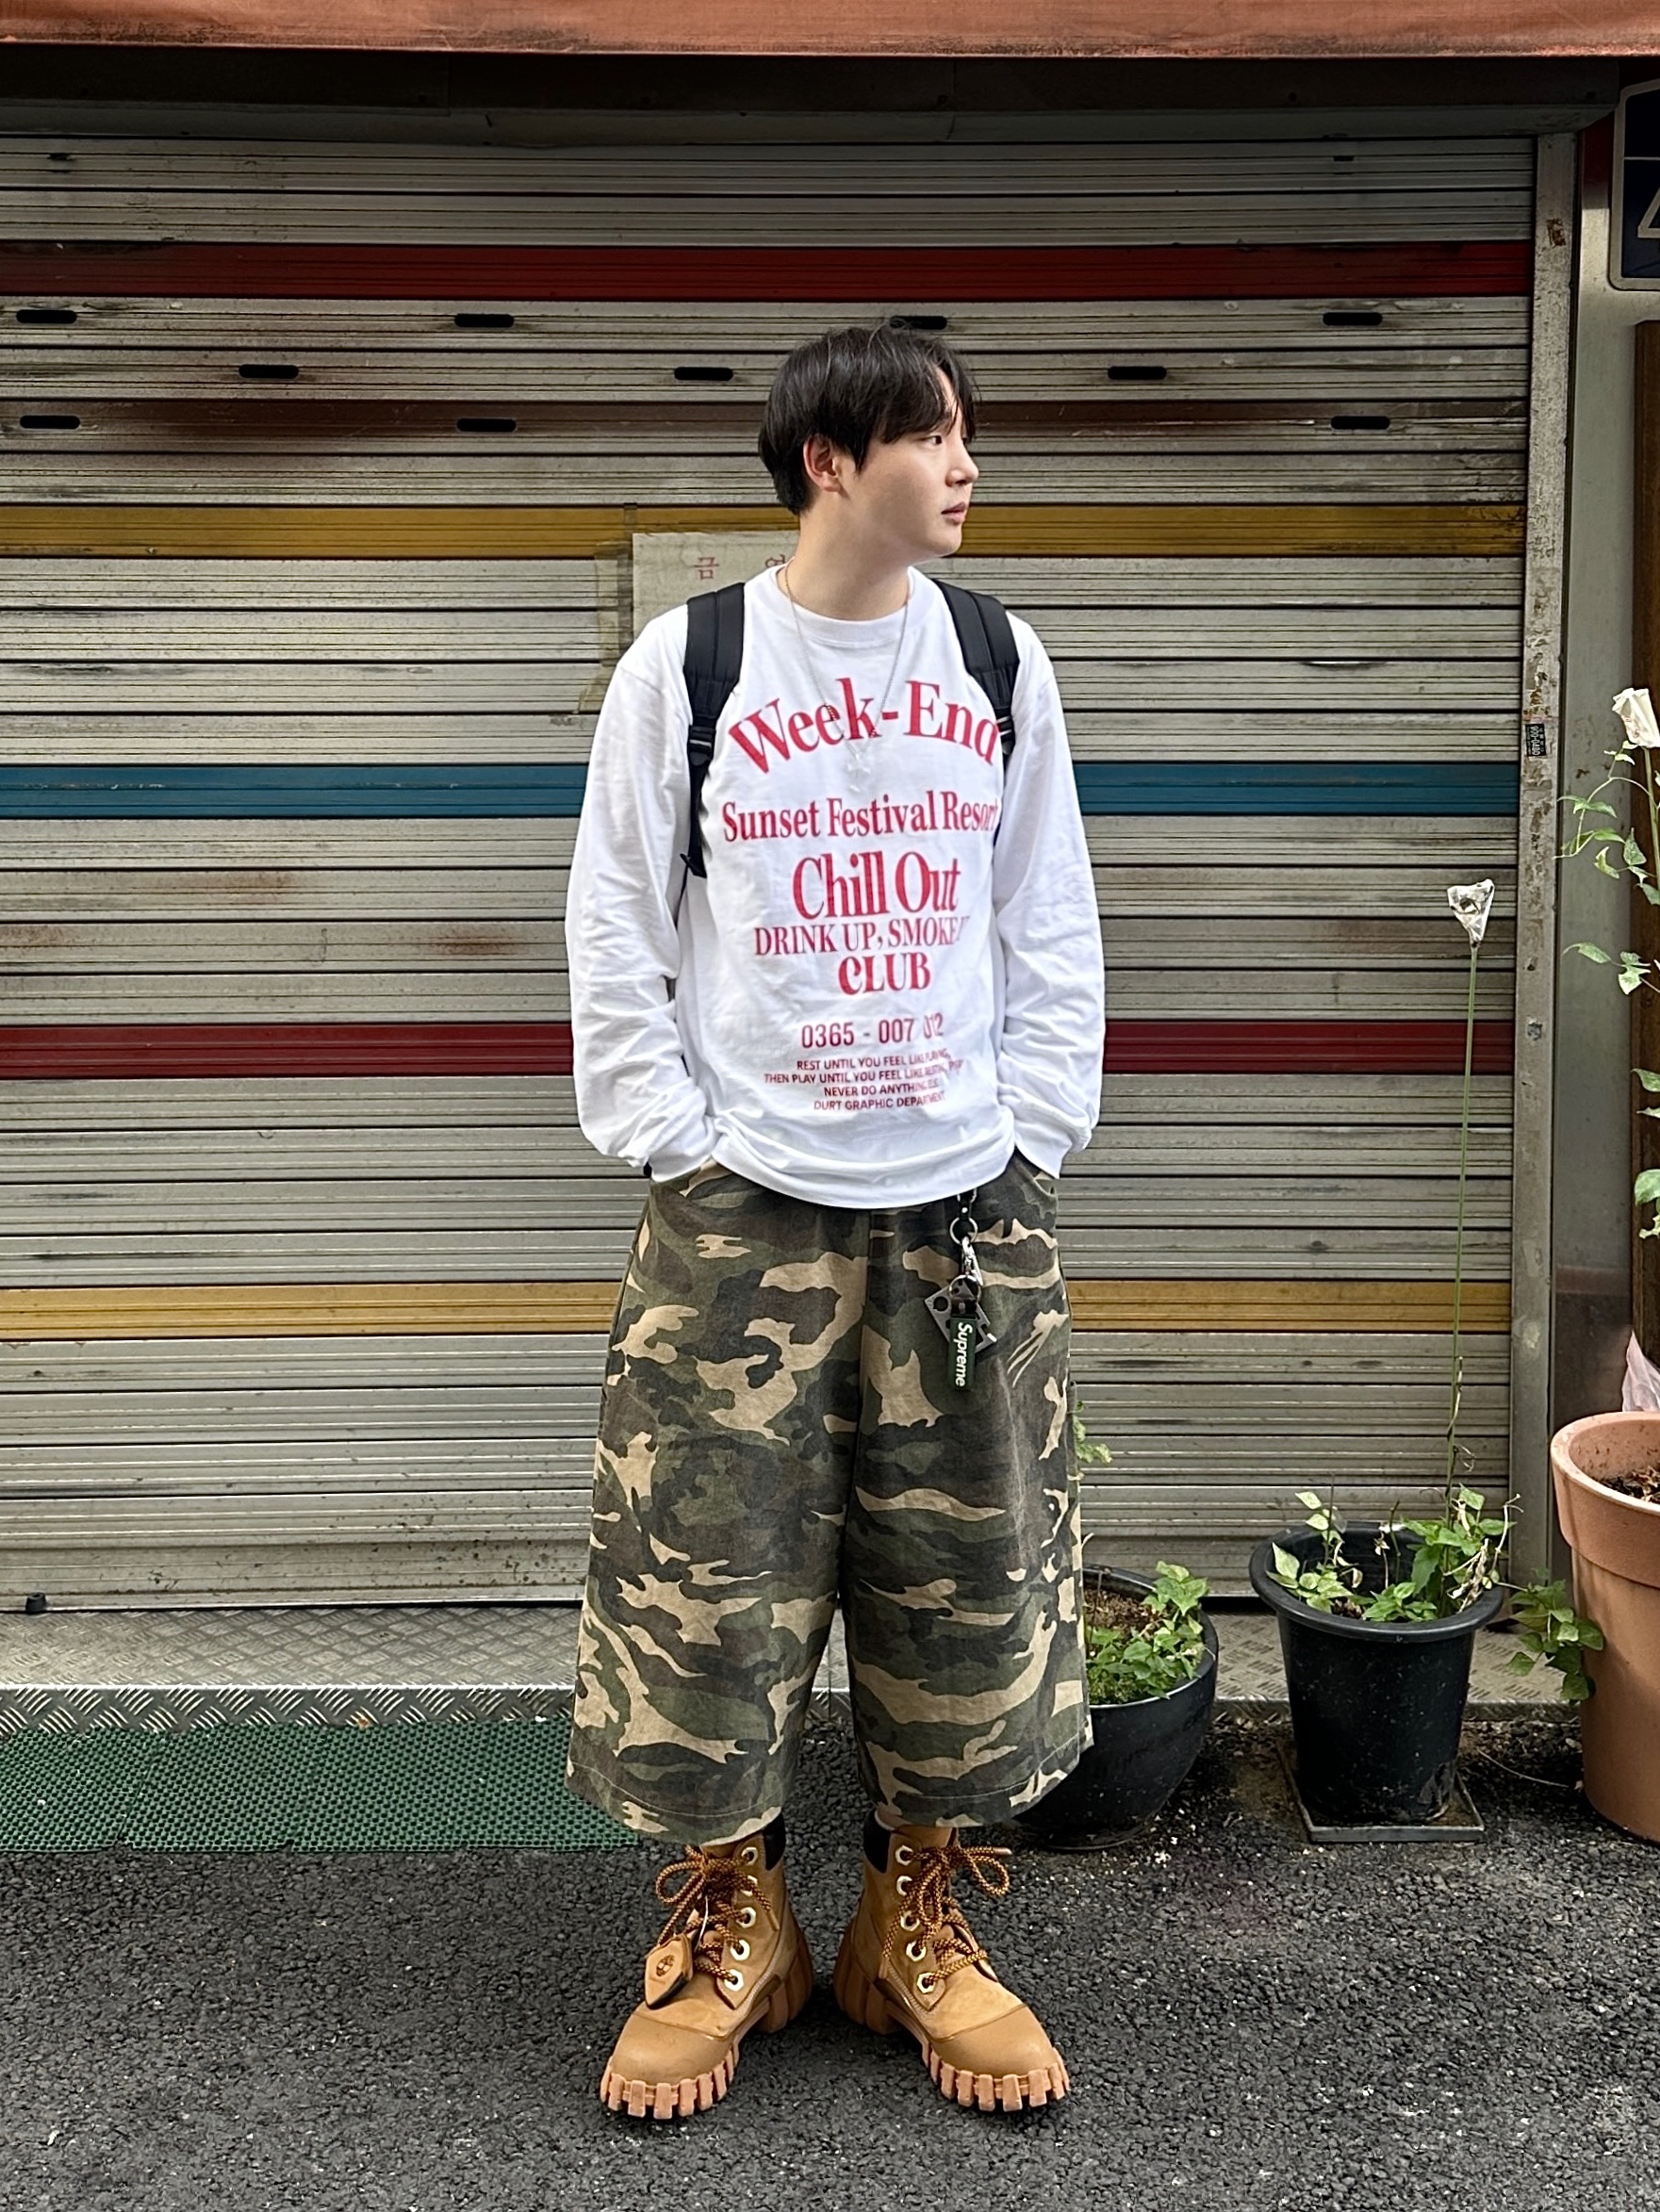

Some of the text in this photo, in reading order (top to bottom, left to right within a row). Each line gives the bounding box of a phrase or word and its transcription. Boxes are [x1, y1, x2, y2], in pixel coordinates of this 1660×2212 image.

[722, 800, 820, 843] Sunset
[826, 790, 937, 837] Festival
[792, 850, 961, 920] Chill Out
[754, 924, 837, 956] DRINK
[841, 922, 883, 950] UP,
[838, 952, 931, 995] CLUB
[801, 1023, 854, 1048] 0365
[879, 1018, 914, 1044] 007
[764, 1073, 789, 1084] THEN
[792, 1073, 816, 1084] PLAY
[819, 1072, 851, 1084] UNTIL
[854, 1071, 876, 1082] YOU
[879, 1069, 902, 1081] FEEL
[797, 1059, 821, 1071] REST
[824, 1057, 856, 1070] UNTIL
[858, 1057, 880, 1069] YOU
[883, 1055, 907, 1067] FEEL
[814, 1100, 842, 1110] DURT
[845, 1096, 894, 1111] GRAPHIC
[823, 1086, 858, 1097] NEVER
[861, 1085, 877, 1096] DO
[953, 1321, 973, 1387] Supreme
